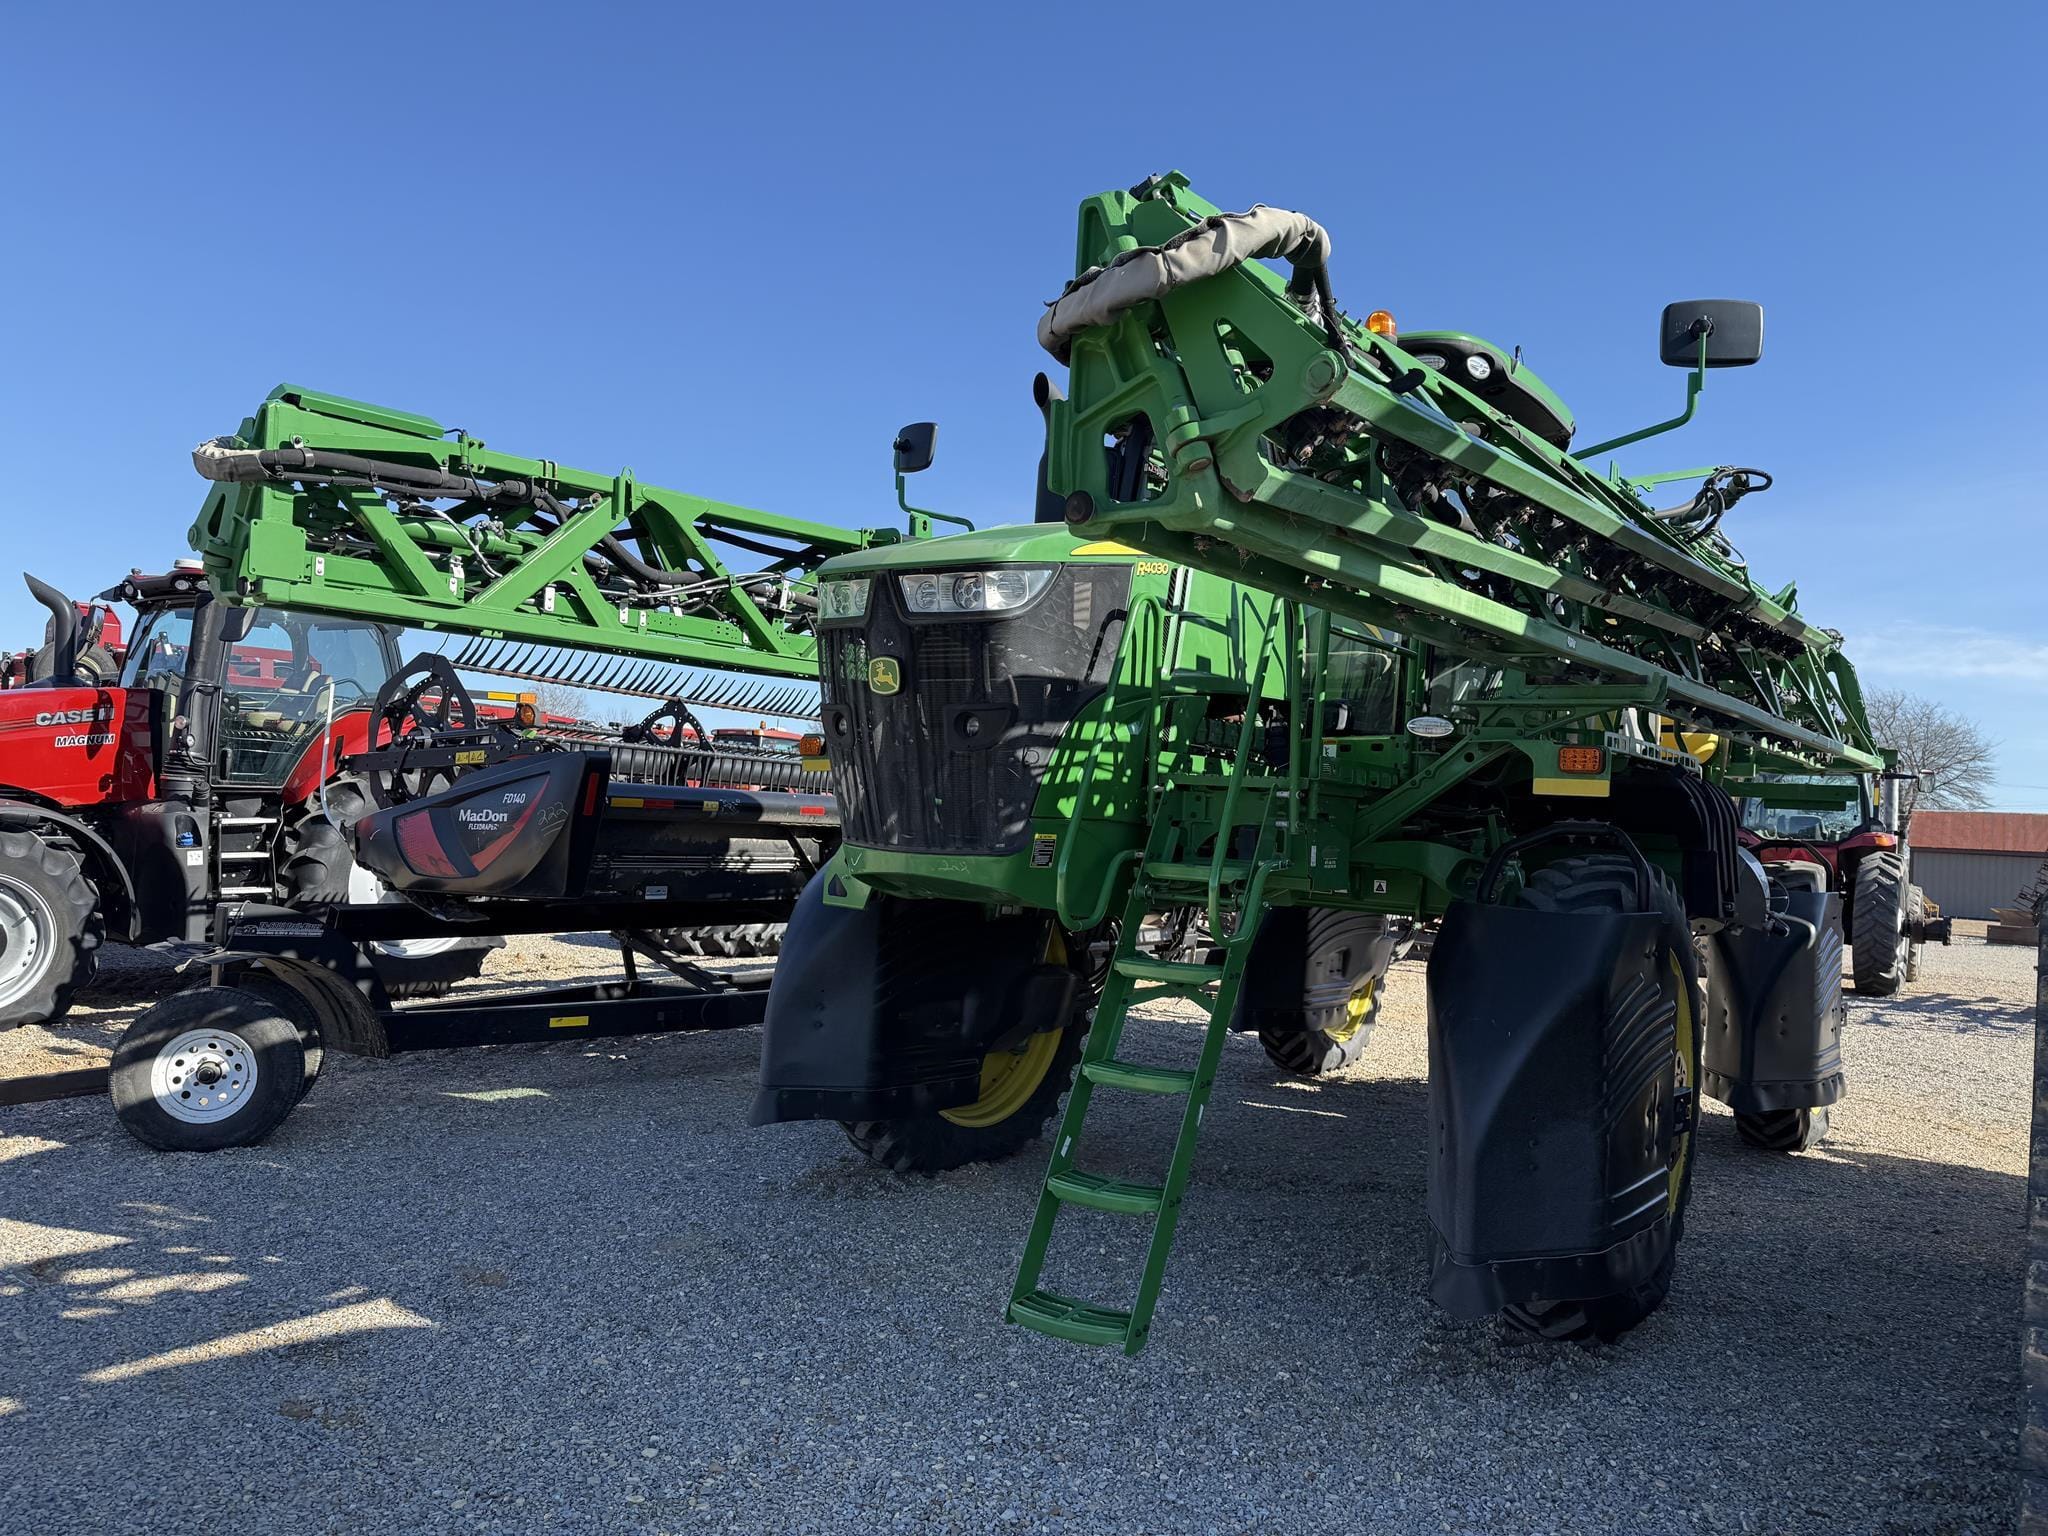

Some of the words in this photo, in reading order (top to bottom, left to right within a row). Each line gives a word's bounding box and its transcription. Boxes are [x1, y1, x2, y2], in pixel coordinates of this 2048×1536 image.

[1136, 561, 1169, 576] R4030
[35, 708, 95, 727] CASE
[55, 734, 116, 747] MAGNUM
[502, 793, 526, 804] FD140
[458, 809, 508, 822] MacDon
